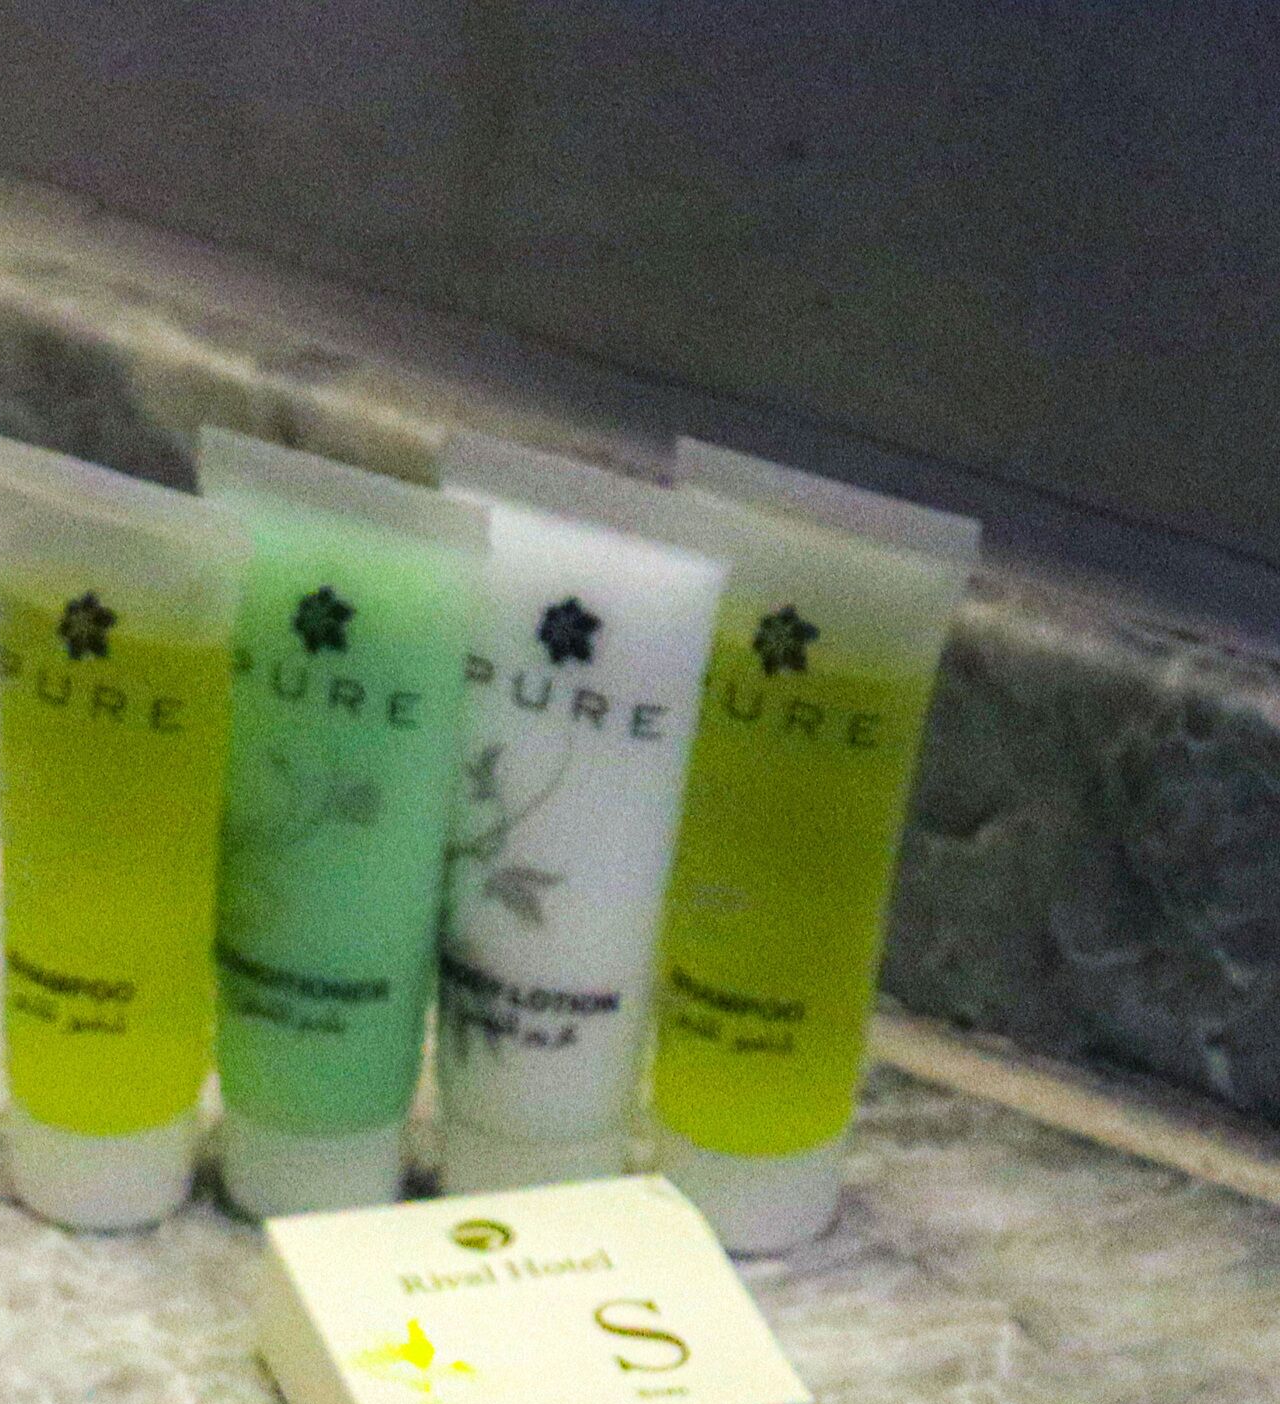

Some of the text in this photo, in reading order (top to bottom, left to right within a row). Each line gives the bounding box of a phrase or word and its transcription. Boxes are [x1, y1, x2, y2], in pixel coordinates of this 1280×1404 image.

[461, 651, 670, 742] PURE
[706, 670, 884, 750] URE
[593, 1299, 691, 1373] S
